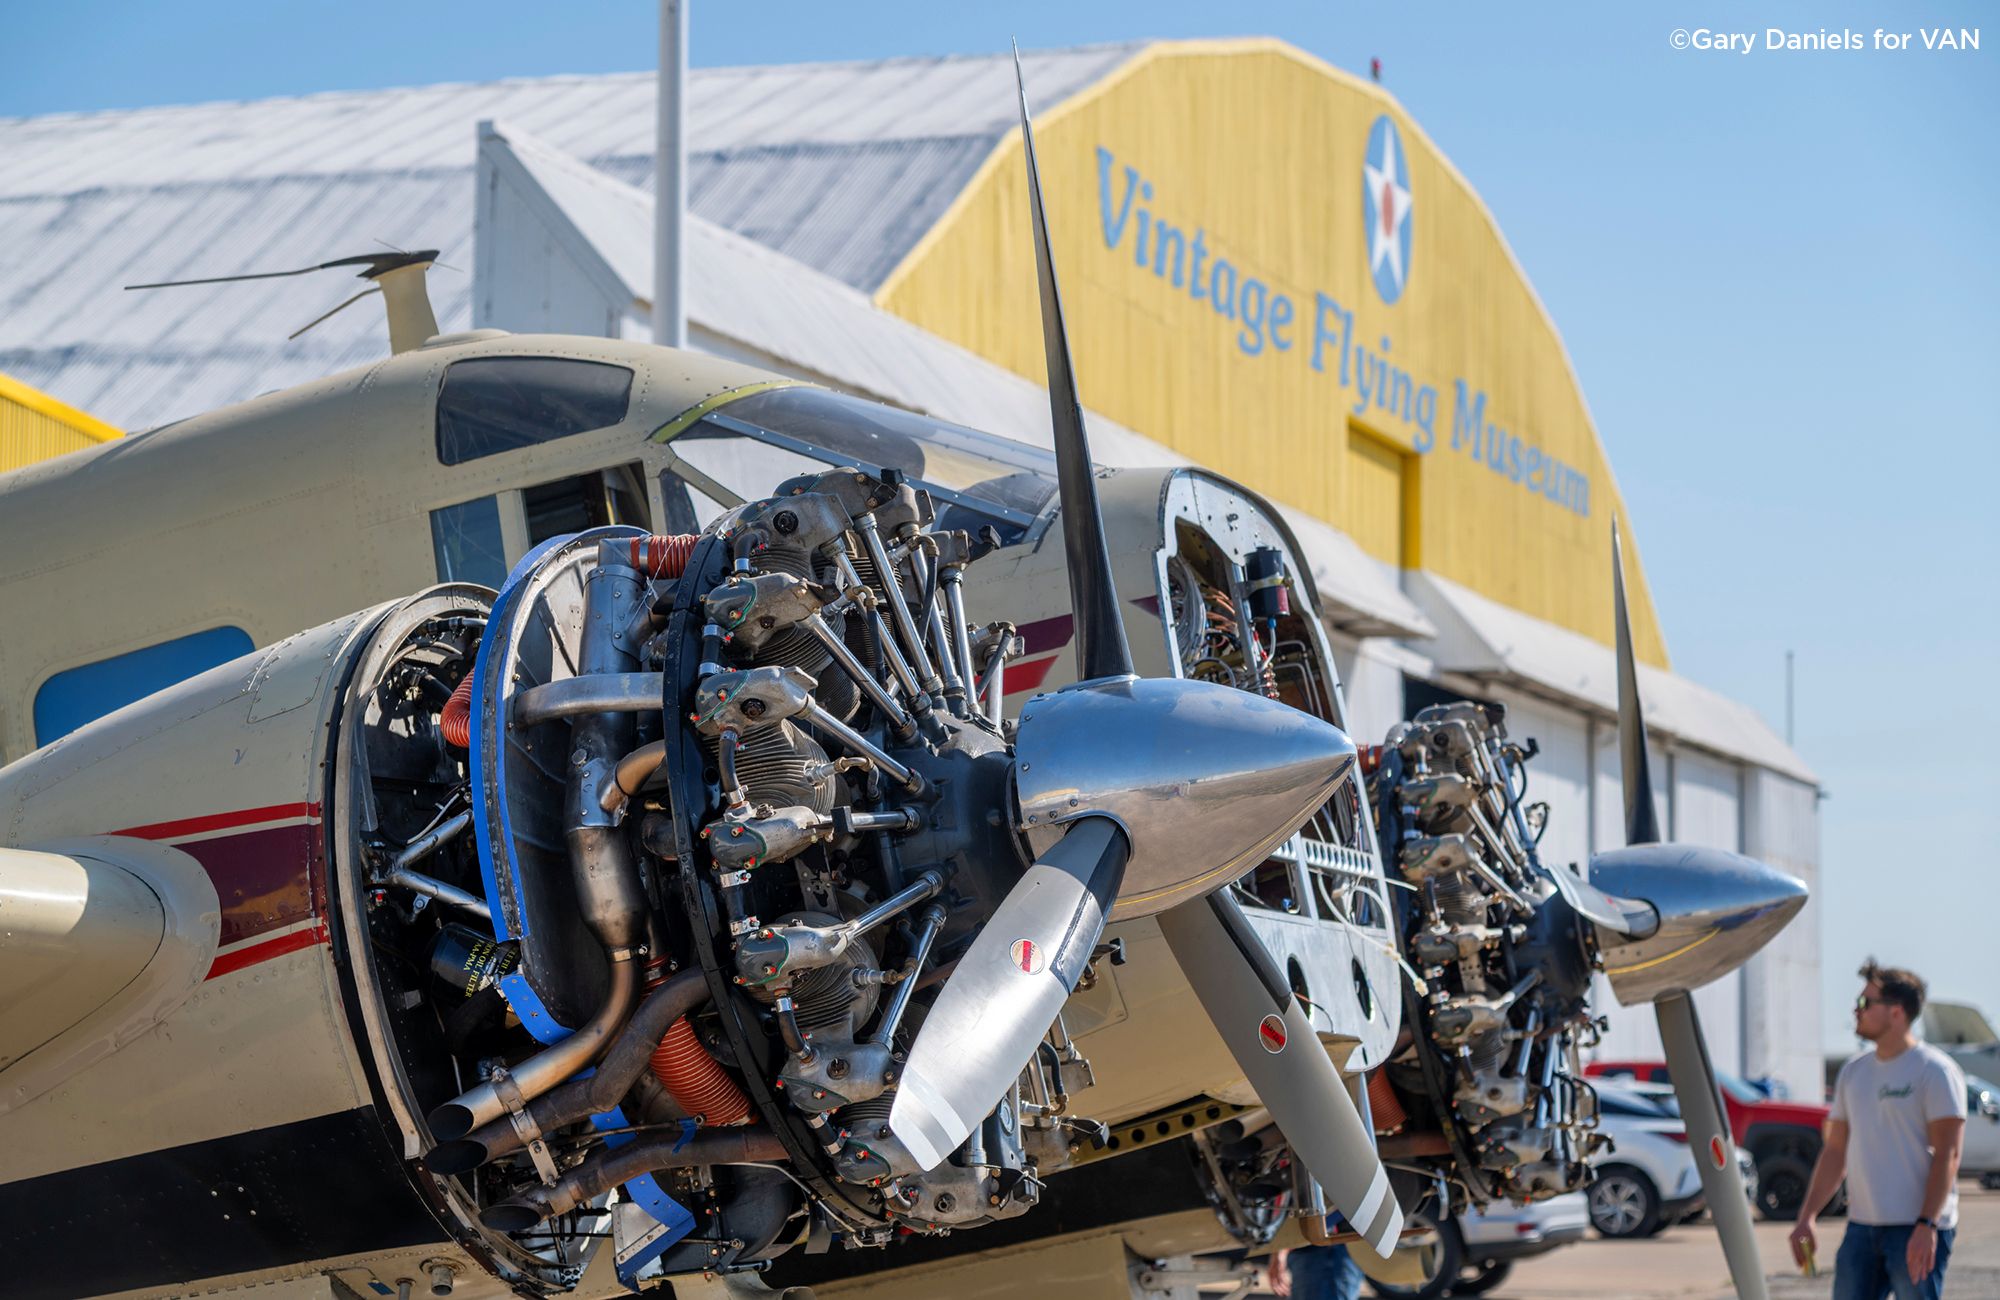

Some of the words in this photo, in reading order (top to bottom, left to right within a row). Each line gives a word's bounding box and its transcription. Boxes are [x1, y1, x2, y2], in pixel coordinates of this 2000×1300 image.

[1096, 146, 1294, 357] Vintage
[1311, 291, 1438, 455] Flying
[1451, 379, 1591, 518] Museum
[464, 970, 480, 998] FILTER
